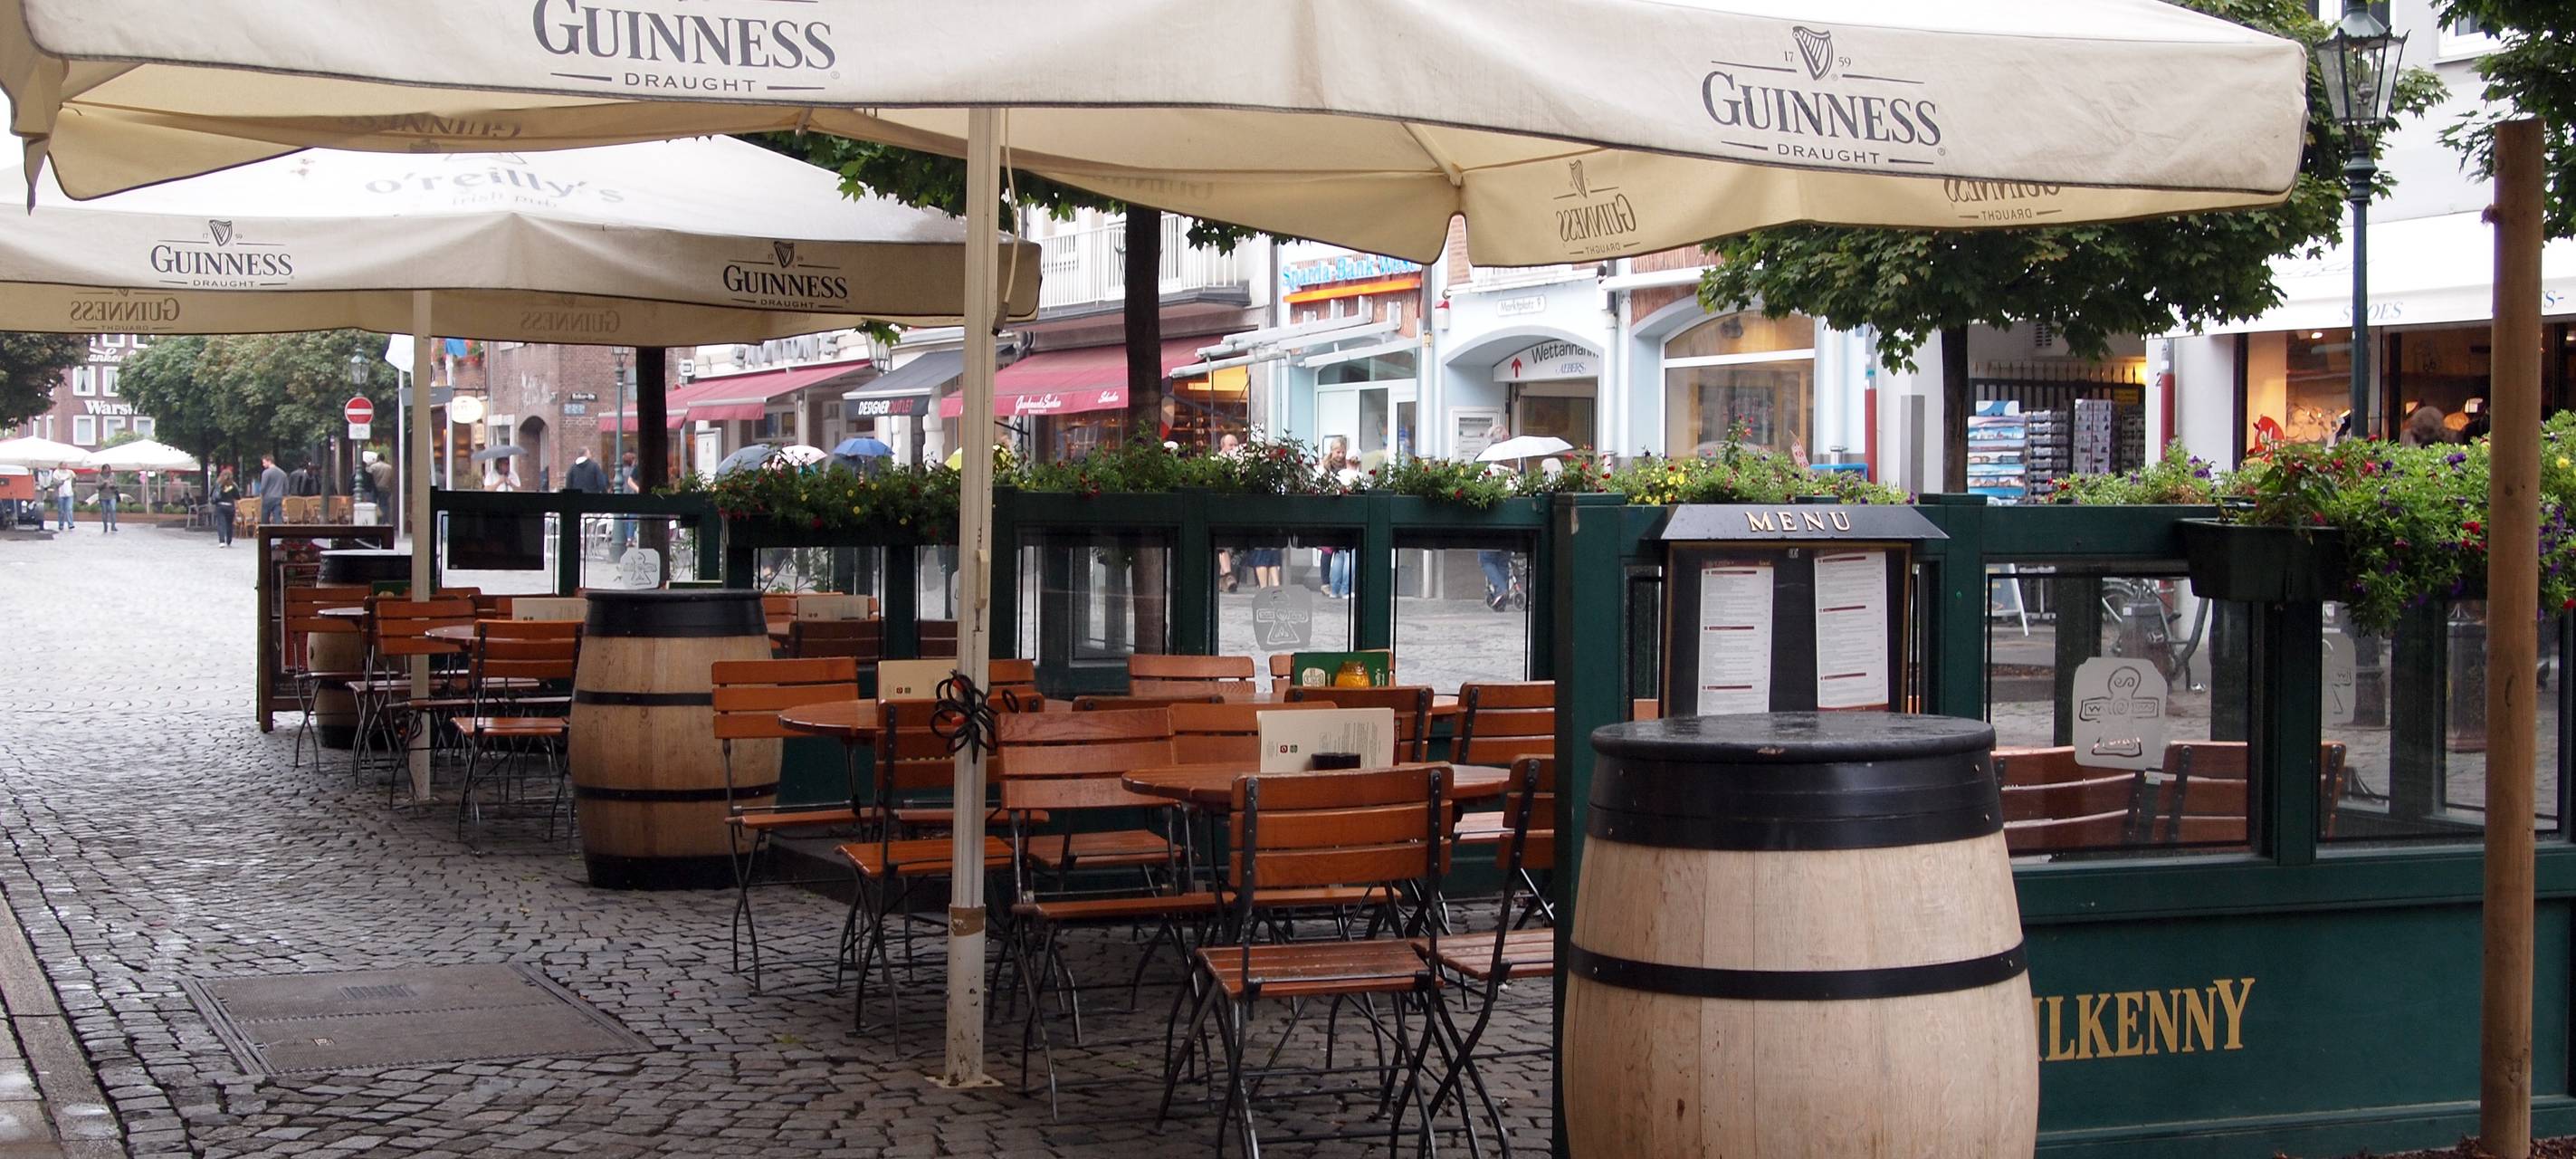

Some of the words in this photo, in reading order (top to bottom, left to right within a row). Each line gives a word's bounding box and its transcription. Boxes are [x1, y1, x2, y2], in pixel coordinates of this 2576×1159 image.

[533, 0, 836, 71] GUINNESS
[1784, 51, 1794, 62] 17
[1838, 56, 1851, 67] 59
[625, 72, 757, 92] DRAUGHT
[1702, 71, 1942, 146] GUINNESS
[1777, 143, 1880, 165] DRAUGHT
[150, 244, 293, 276] GUINNESS
[193, 279, 255, 288] DRAUGHT
[722, 264, 848, 299] GUINNESS
[1283, 255, 1375, 292] Sparda-Bank
[760, 298, 815, 309] DRAUGHT
[2340, 300, 2403, 322] SOES
[1745, 511, 1850, 532] MENU
